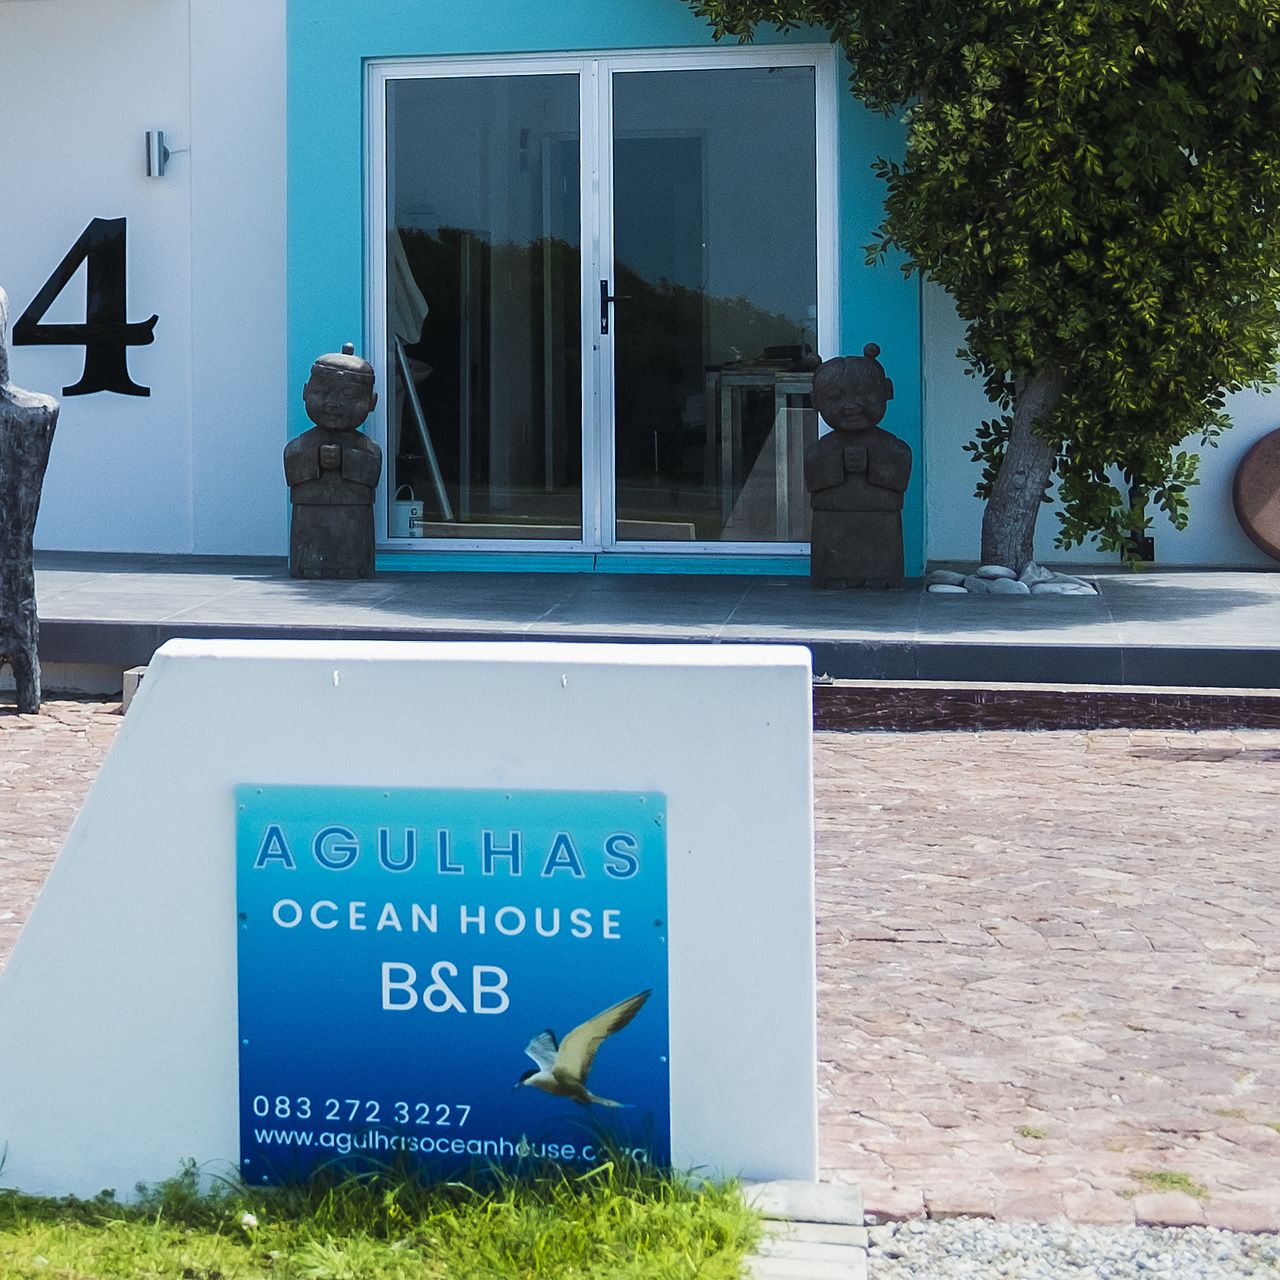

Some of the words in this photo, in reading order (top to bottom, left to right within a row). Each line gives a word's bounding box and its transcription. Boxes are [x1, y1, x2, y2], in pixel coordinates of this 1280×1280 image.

[12, 217, 159, 397] 4
[254, 824, 640, 880] AGULHAS
[272, 898, 438, 933] OCEAN
[460, 905, 622, 939] HOUSE
[381, 961, 510, 1014] B&B
[253, 1095, 311, 1119] 083
[325, 1099, 381, 1123] 272
[394, 1102, 471, 1126] 3227
